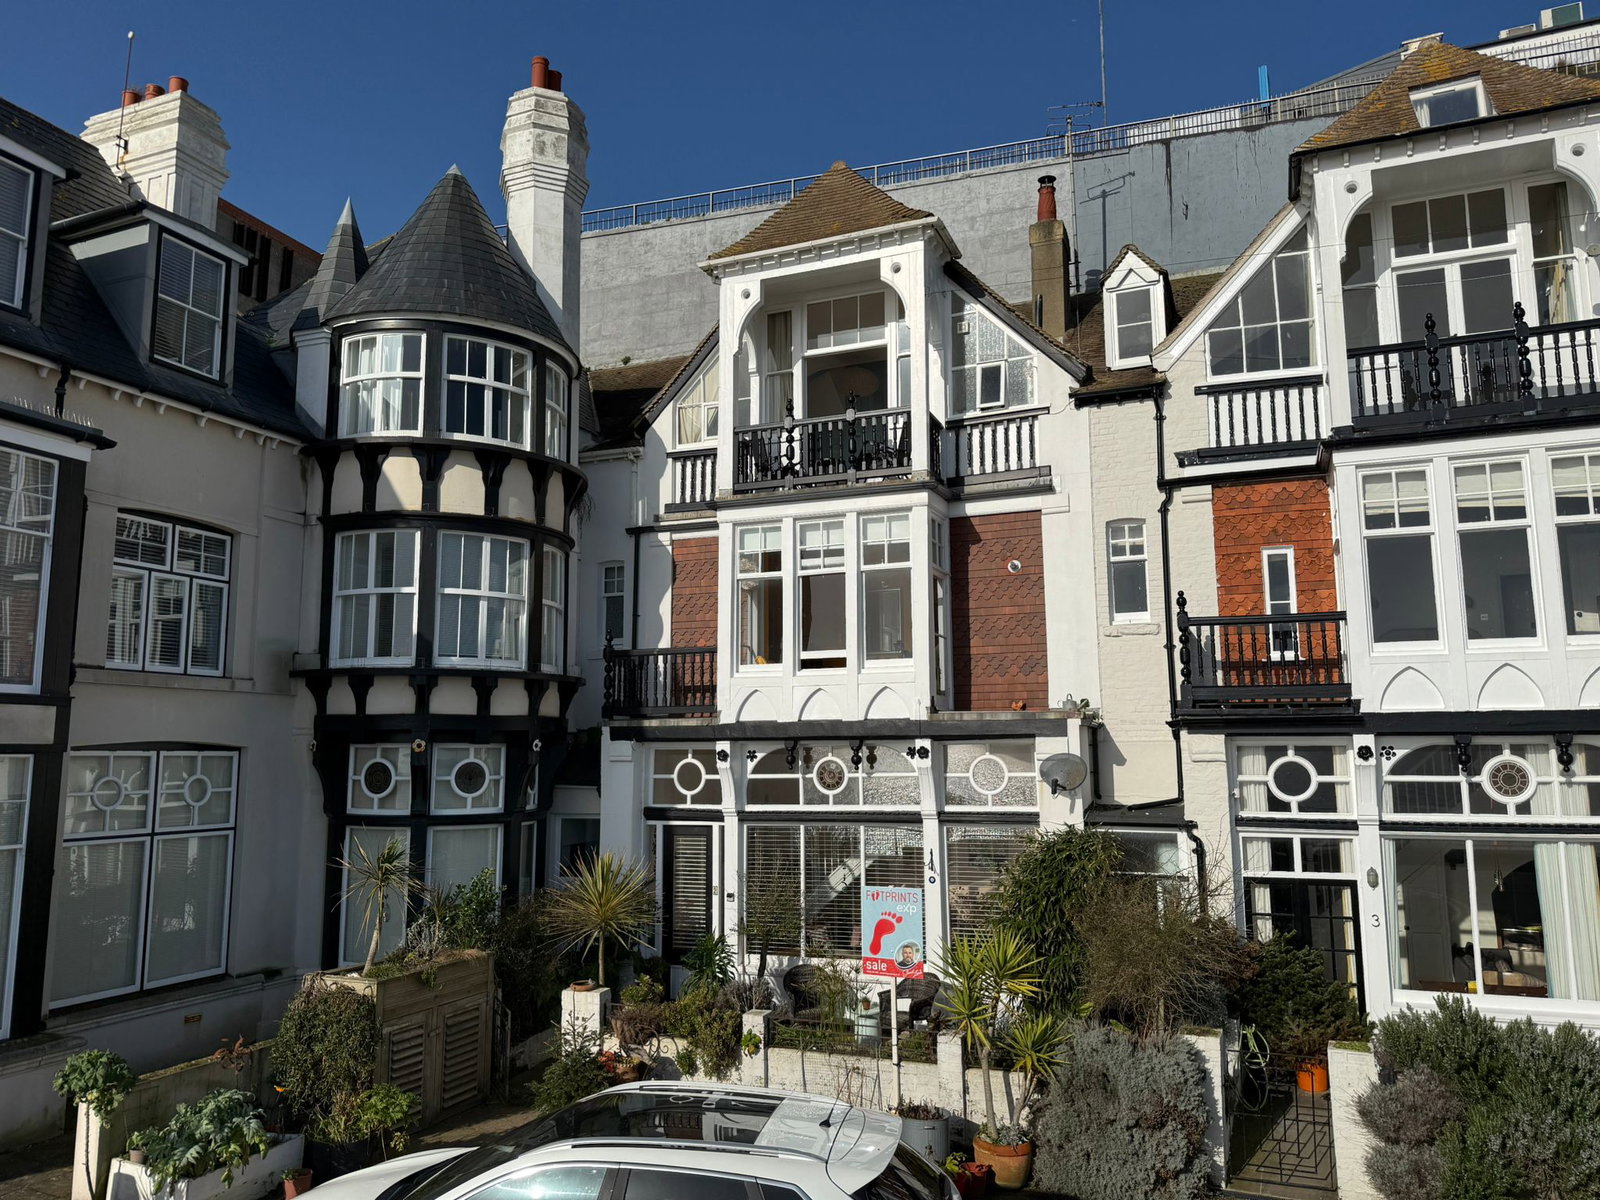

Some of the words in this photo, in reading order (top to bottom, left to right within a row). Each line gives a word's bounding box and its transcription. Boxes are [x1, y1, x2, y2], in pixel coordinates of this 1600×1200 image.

[897, 904, 917, 915] exp
[1371, 914, 1380, 927] 3
[866, 959, 887, 971] sale
